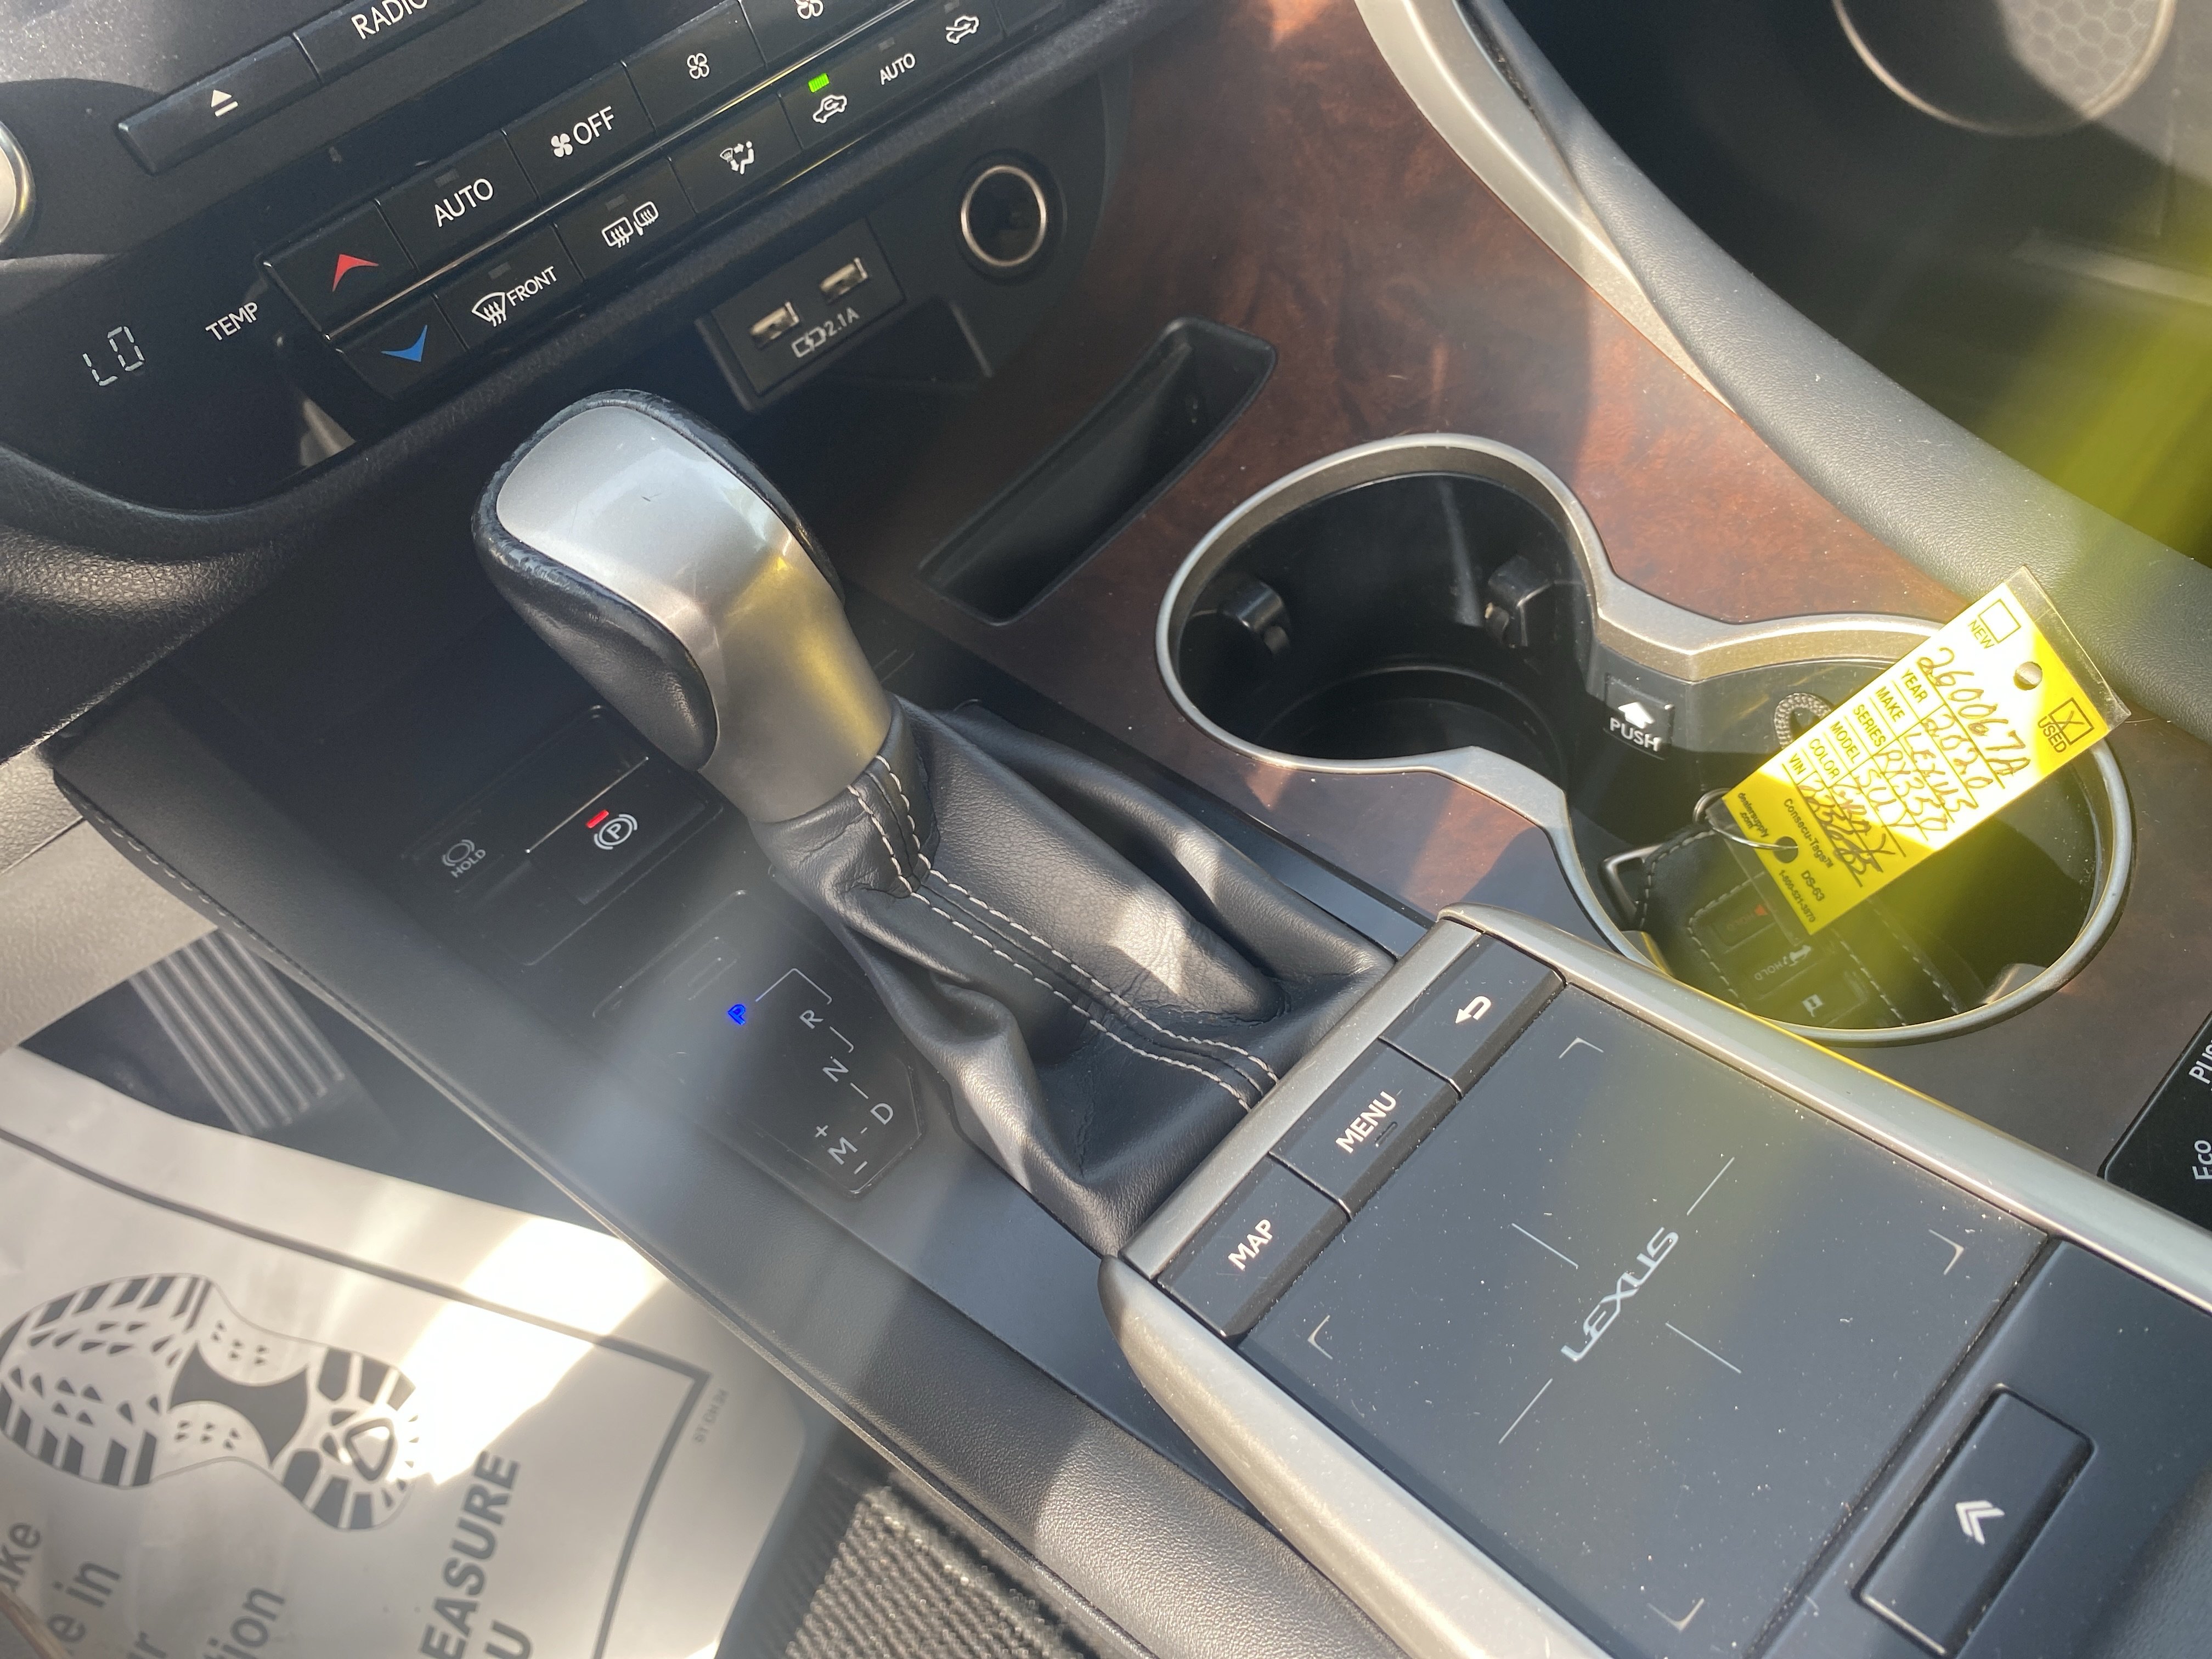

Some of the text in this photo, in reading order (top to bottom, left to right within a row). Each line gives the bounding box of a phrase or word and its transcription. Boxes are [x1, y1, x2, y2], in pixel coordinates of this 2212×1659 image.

[879, 53, 916, 86] AUTO
[573, 105, 614, 145] OFF
[433, 178, 493, 227] AUTO
[506, 266, 558, 307] FRONT
[205, 302, 259, 342] TEMP
[823, 306, 859, 342] 2.1A
[1967, 619, 1995, 649] NEW
[1610, 717, 1663, 752] PUSH
[1830, 721, 1861, 764] MODEL
[1853, 704, 1886, 747] SERIES
[1901, 668, 1994, 788] YEAR 2020
[2038, 715, 2067, 753] USED
[1790, 753, 1807, 775] VIN
[1809, 739, 1840, 779] COLOR
[1875, 686, 1979, 814] MAKE LEXUS
[450, 849, 486, 878] HOLD
[1801, 870, 1825, 902] DS-63
[727, 1003, 747, 1025] P
[799, 1009, 824, 1030] R
[822, 1058, 849, 1082] N
[870, 1102, 895, 1125] D
[1335, 1091, 1397, 1153] MENU
[827, 1136, 859, 1166] M
[1227, 1218, 1274, 1271] MAP
[1560, 1227, 1679, 1362] LEXUS
[55, 1561, 121, 1607] in
